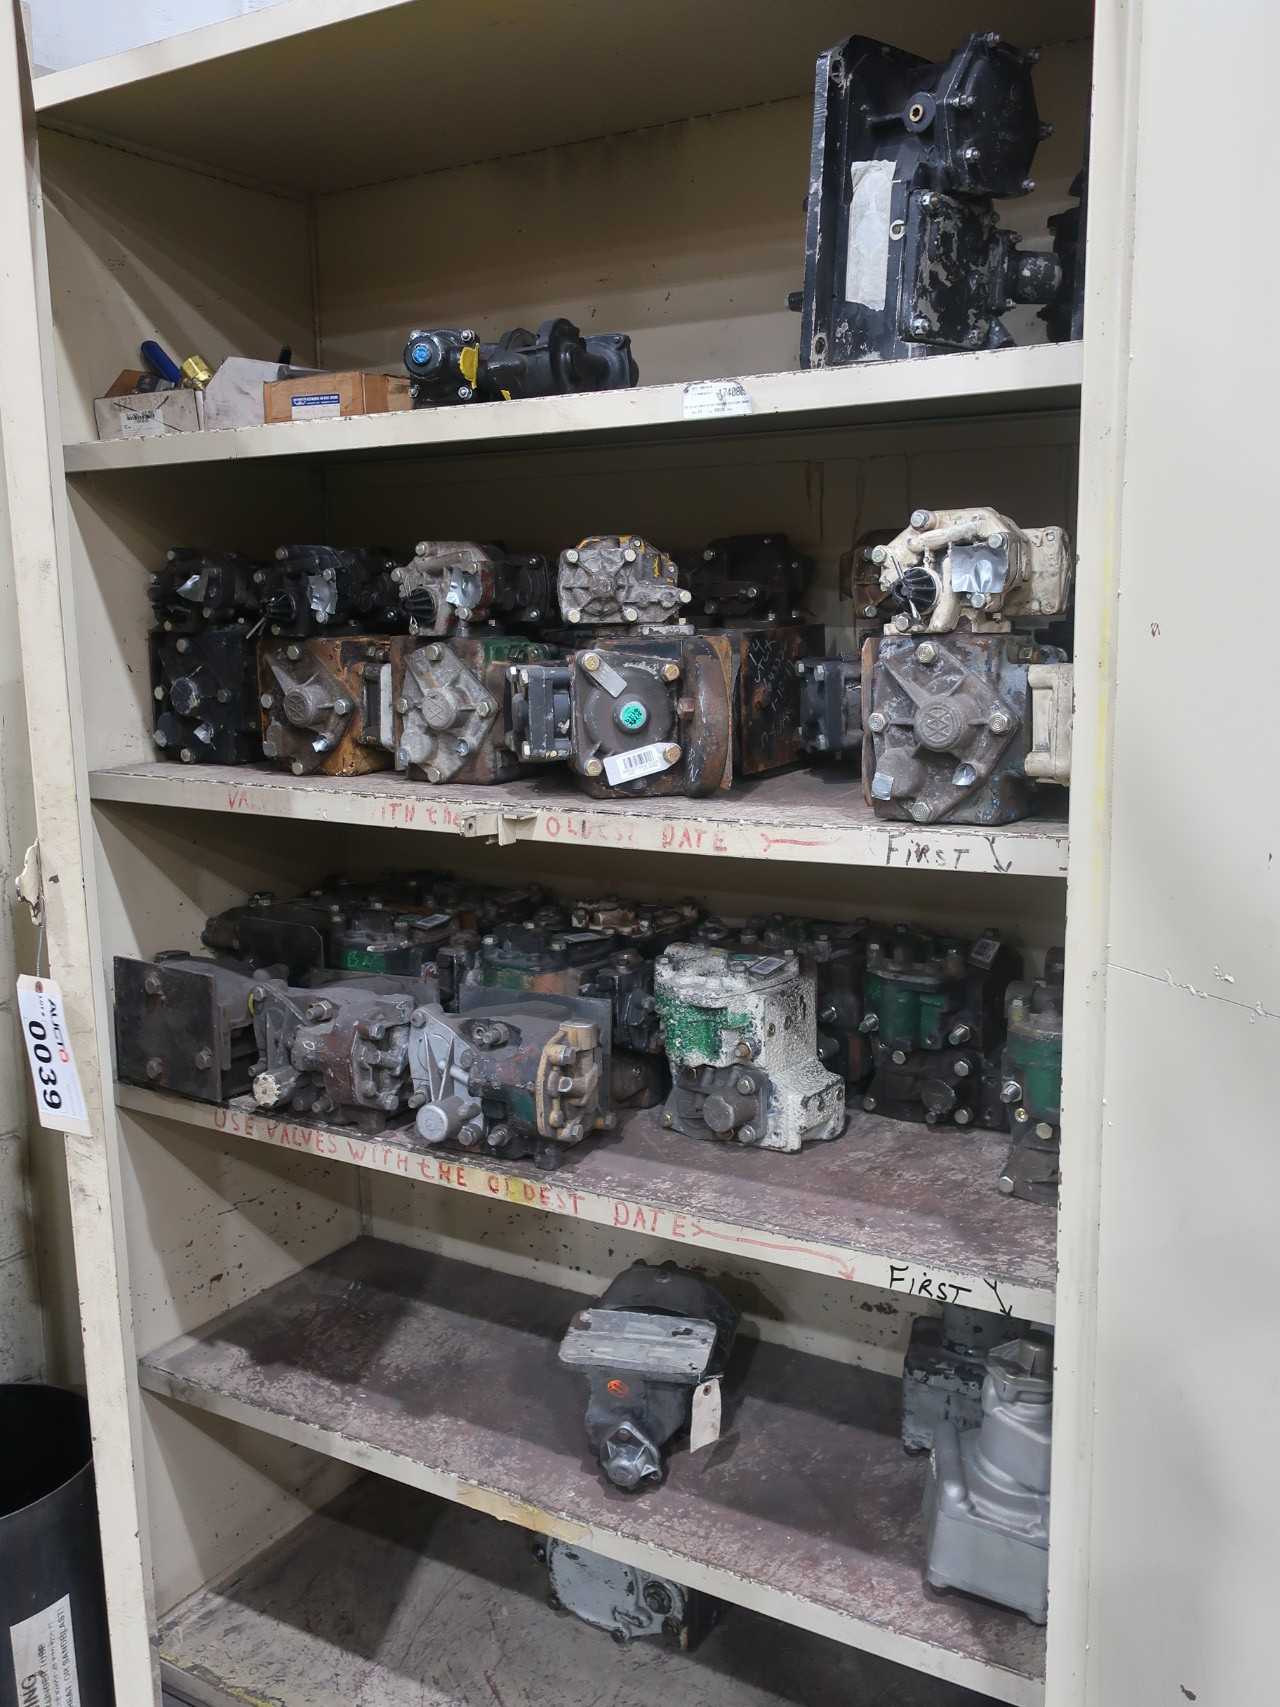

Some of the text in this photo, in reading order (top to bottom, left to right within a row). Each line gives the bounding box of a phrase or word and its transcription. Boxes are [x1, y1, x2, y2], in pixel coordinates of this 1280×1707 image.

[28, 1020, 62, 1110] 0039
[214, 1108, 254, 1136] USE
[267, 1118, 338, 1155] VALVES
[348, 1141, 409, 1174] WITH
[20, 1671, 41, 1707] ING
